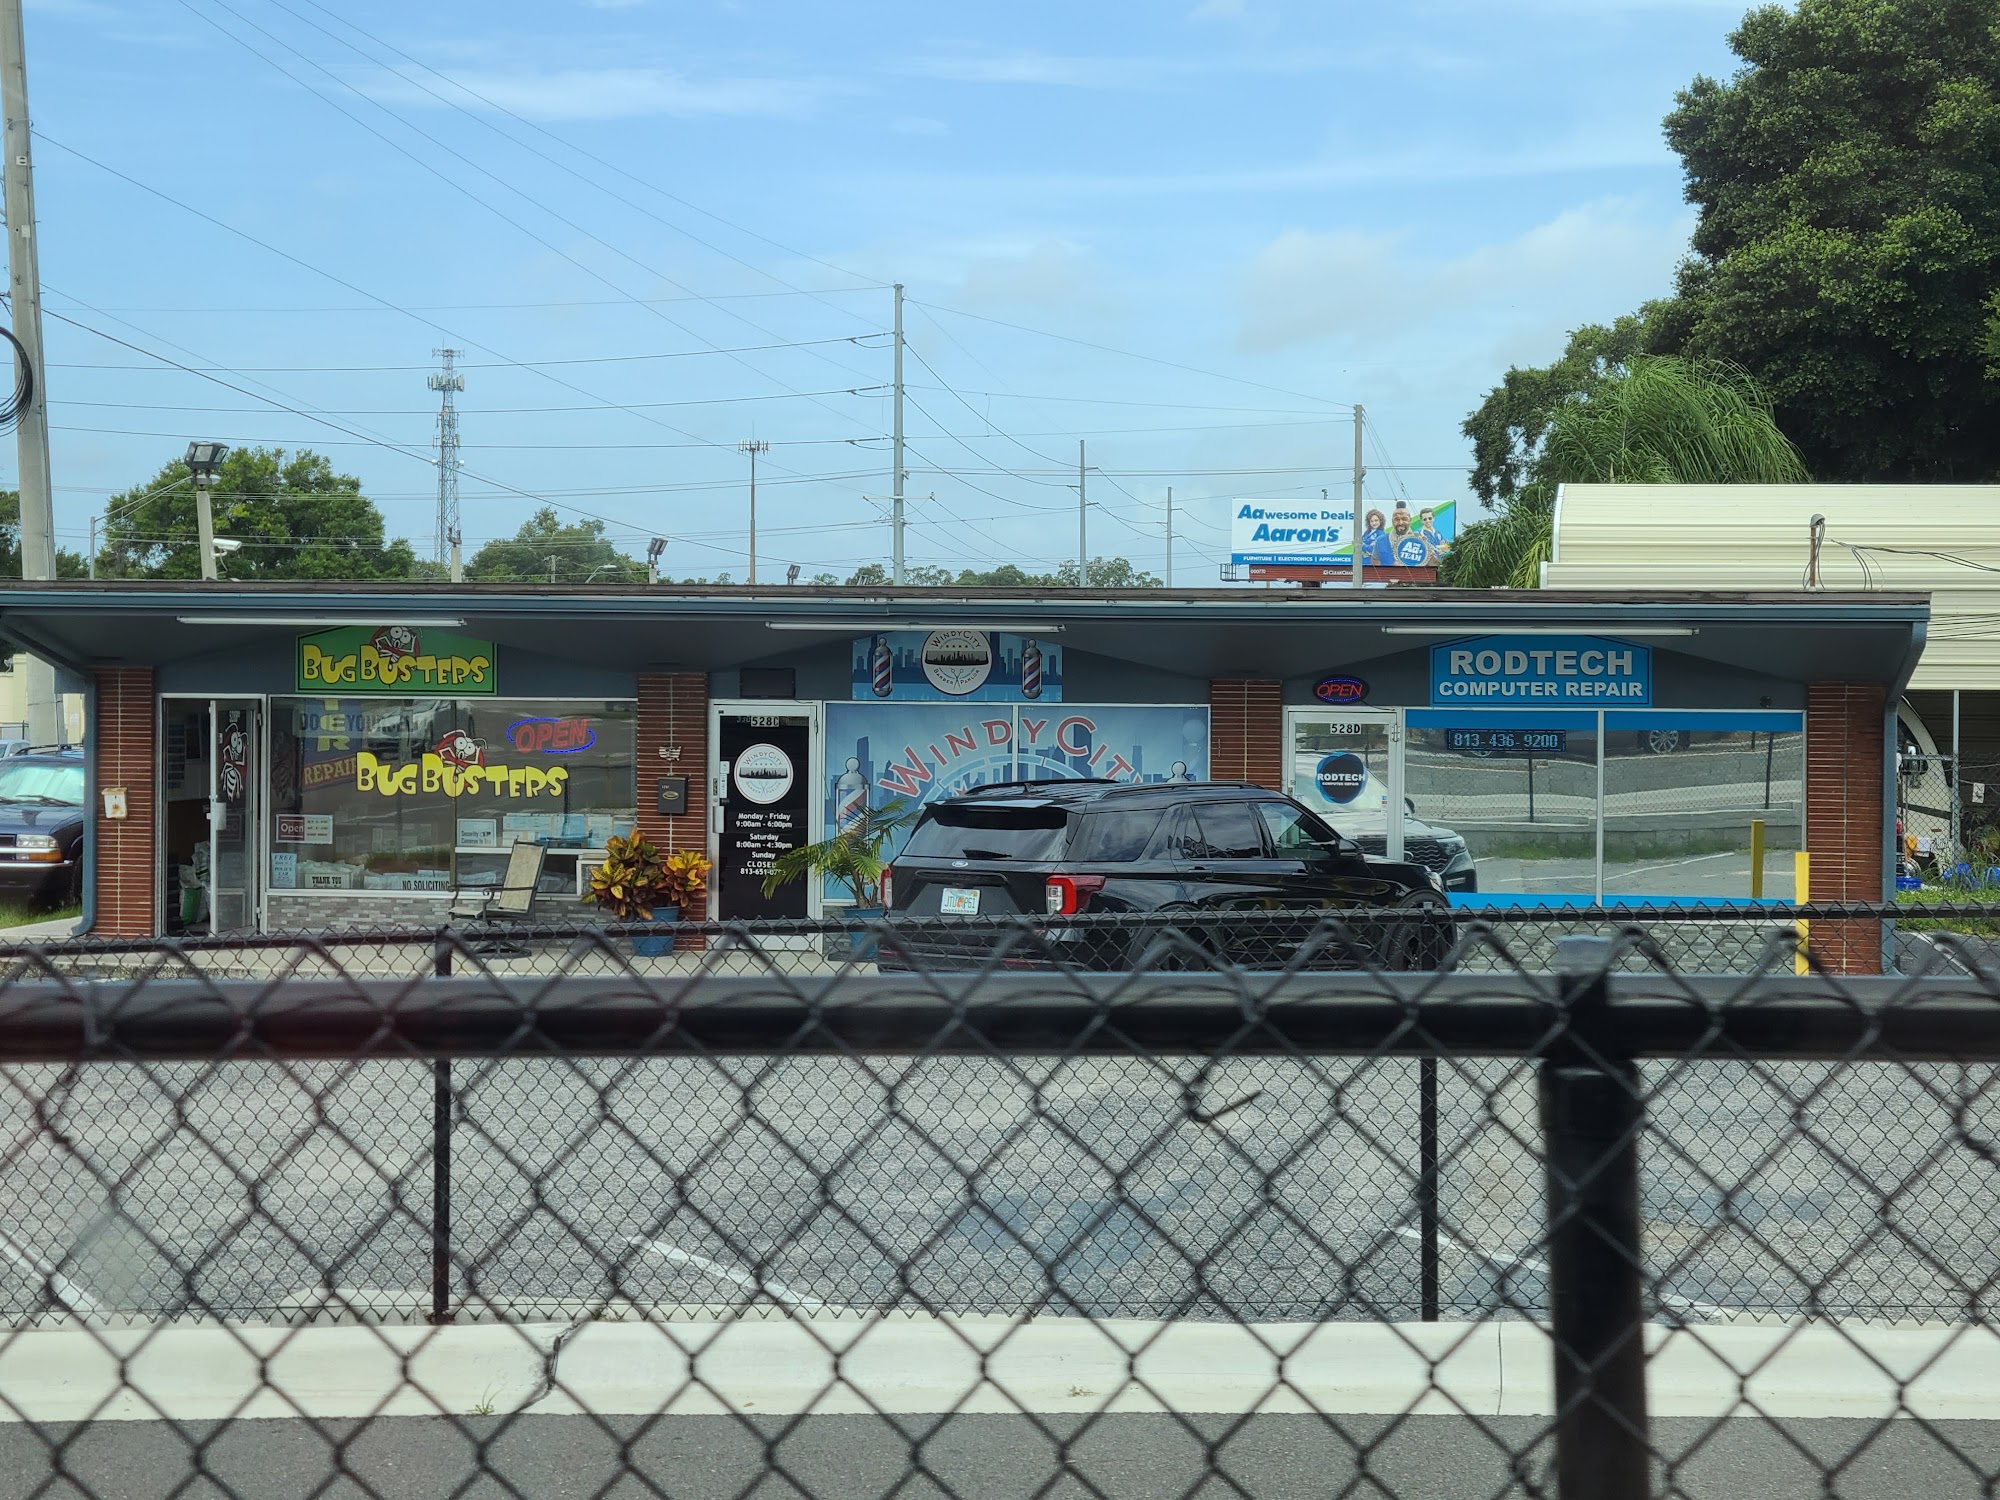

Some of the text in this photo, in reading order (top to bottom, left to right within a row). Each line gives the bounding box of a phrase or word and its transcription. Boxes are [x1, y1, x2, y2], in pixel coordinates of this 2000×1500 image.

[1237, 504, 1354, 520] Aawesome Deals
[1252, 523, 1340, 543] Aaron's
[1450, 650, 1633, 676] RODTECH
[1317, 683, 1363, 697] OPEN
[1439, 681, 1643, 697] COMPUTER REPAIR
[1331, 723, 1361, 734] 528D
[515, 718, 588, 753] OPEN
[1317, 773, 1366, 781] RODTECH
[738, 812, 764, 821] Monday
[769, 813, 791, 821] Friday
[280, 823, 304, 834] Open
[735, 820, 762, 828] 9:00am
[767, 821, 793, 829] 6:00pm
[749, 833, 779, 841] Saturday
[766, 842, 793, 850] 4:30pm
[751, 851, 776, 859] Sunday
[312, 876, 330, 884] THANK
[402, 880, 450, 890] NO SOLICITING
